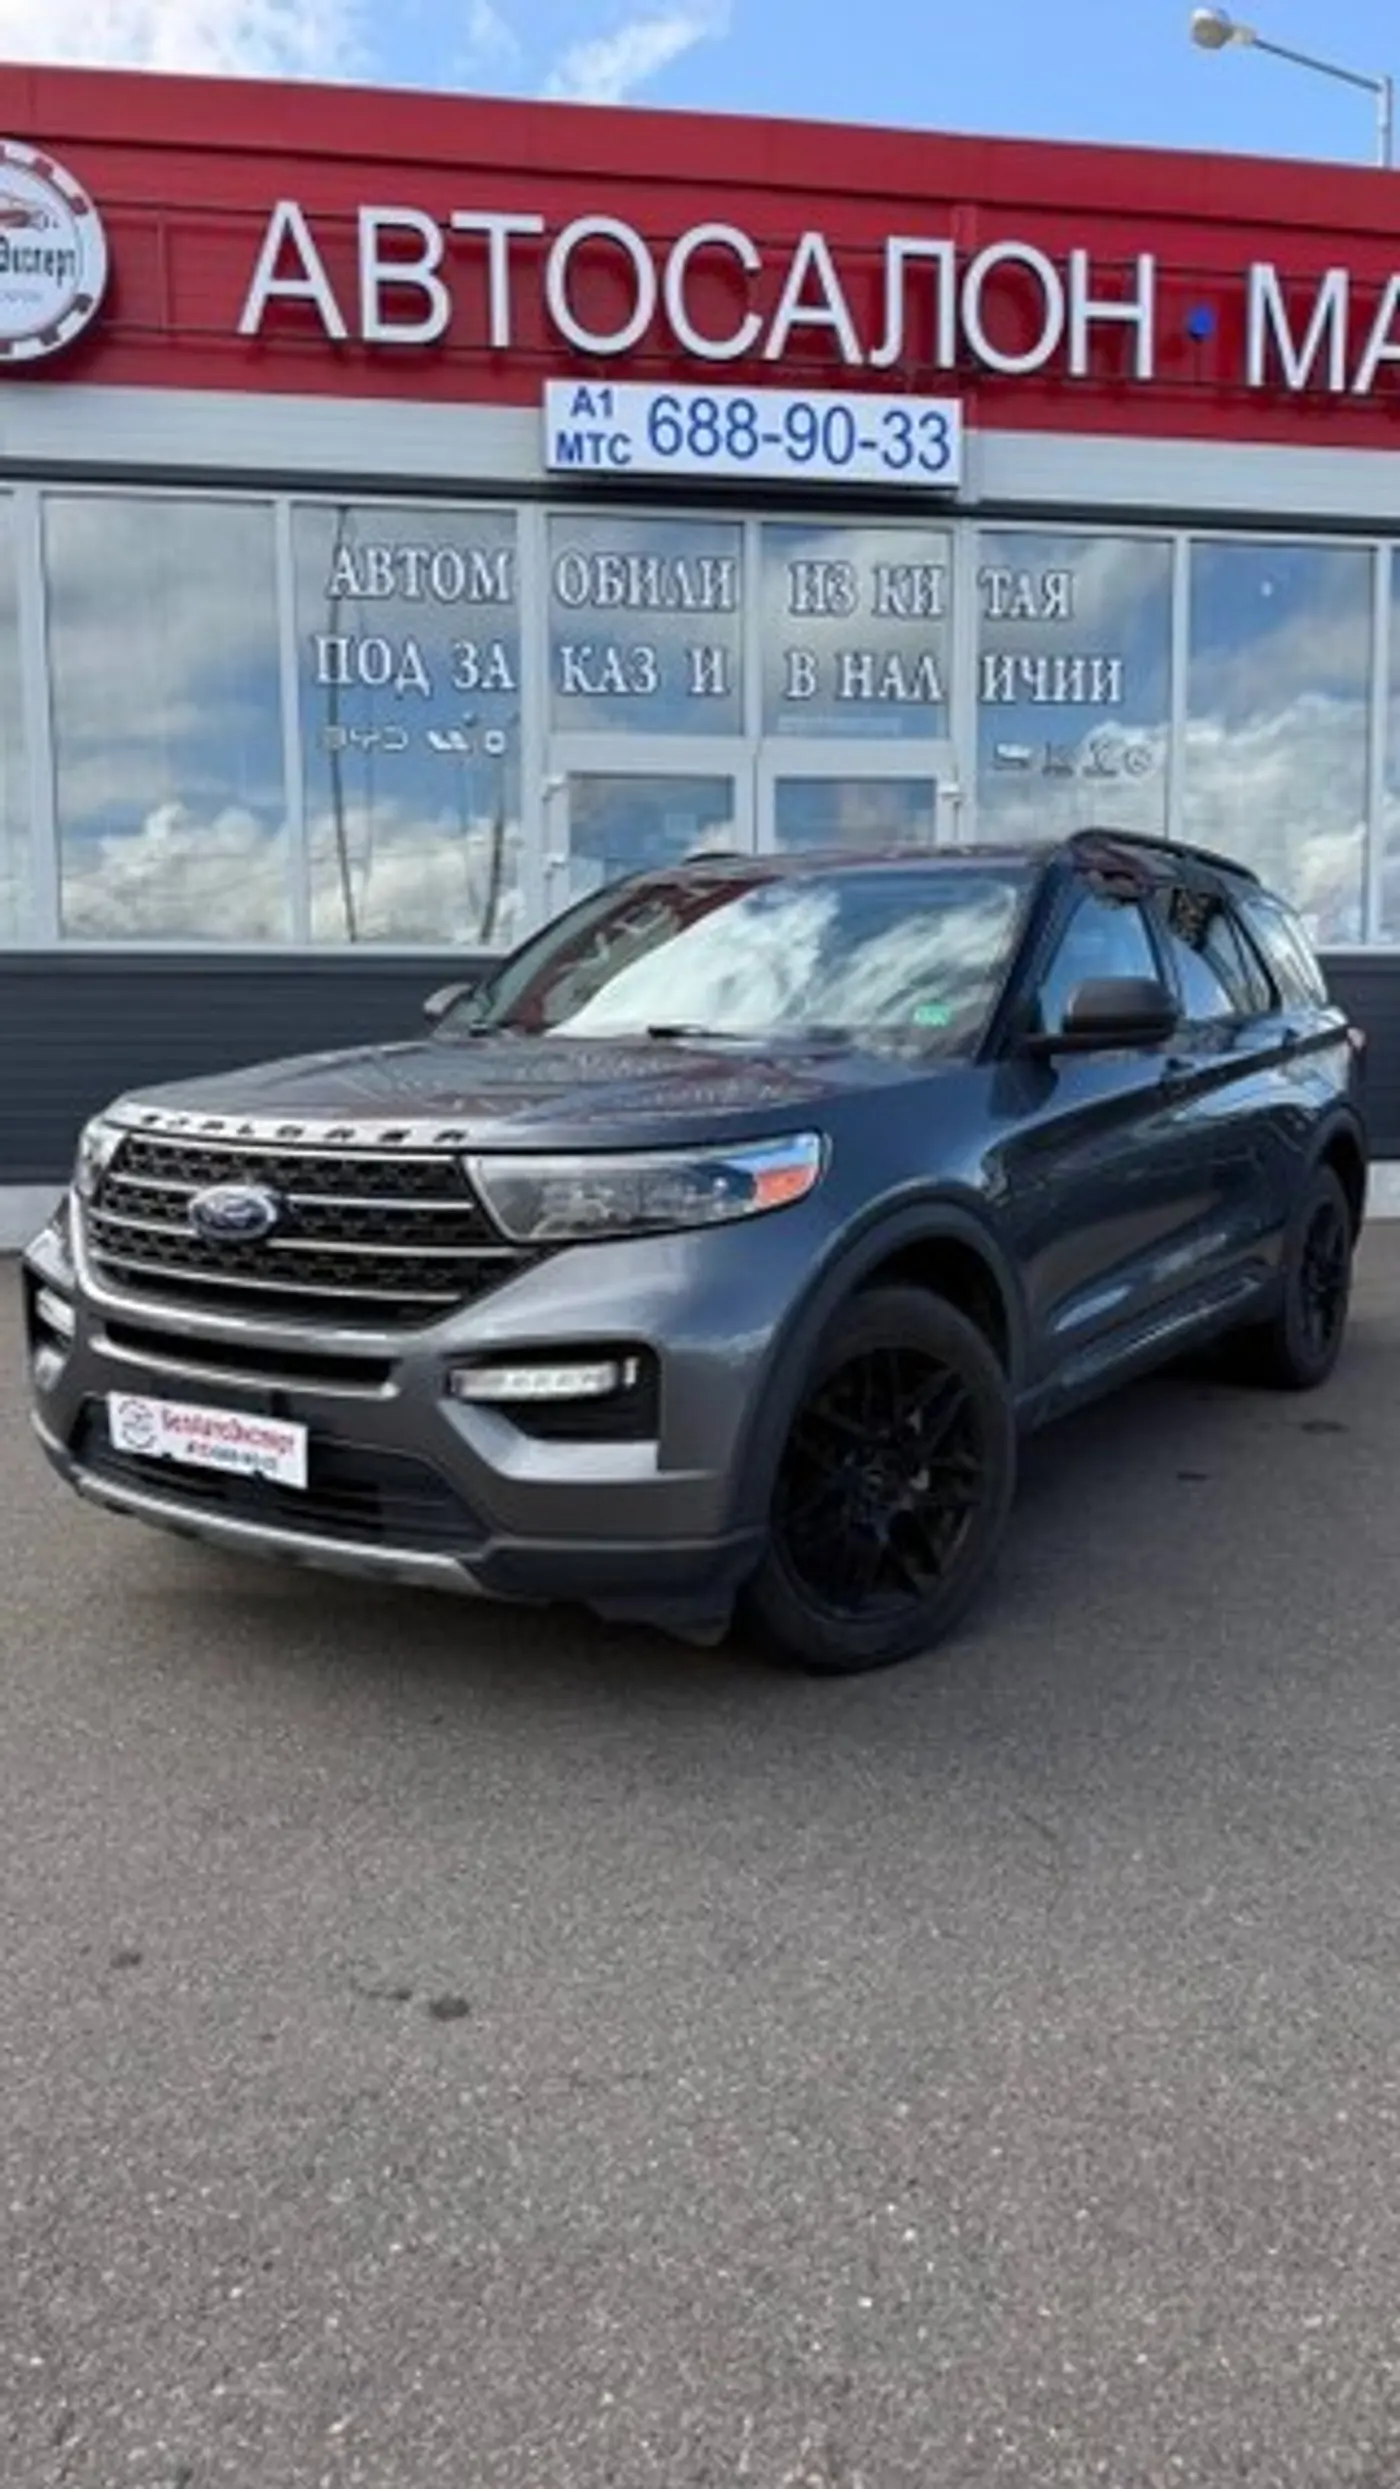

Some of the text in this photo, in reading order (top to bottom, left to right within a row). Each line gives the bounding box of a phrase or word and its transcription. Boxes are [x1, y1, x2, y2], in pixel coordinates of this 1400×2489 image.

[238, 200, 1155, 379] АВТОСАЛОН
[556, 431, 633, 466] МТС
[647, 394, 951, 472] 688-90-33
[788, 560, 857, 617] ИЗ
[314, 633, 433, 697] ПОД
[688, 647, 729, 696] И
[786, 650, 817, 699] В
